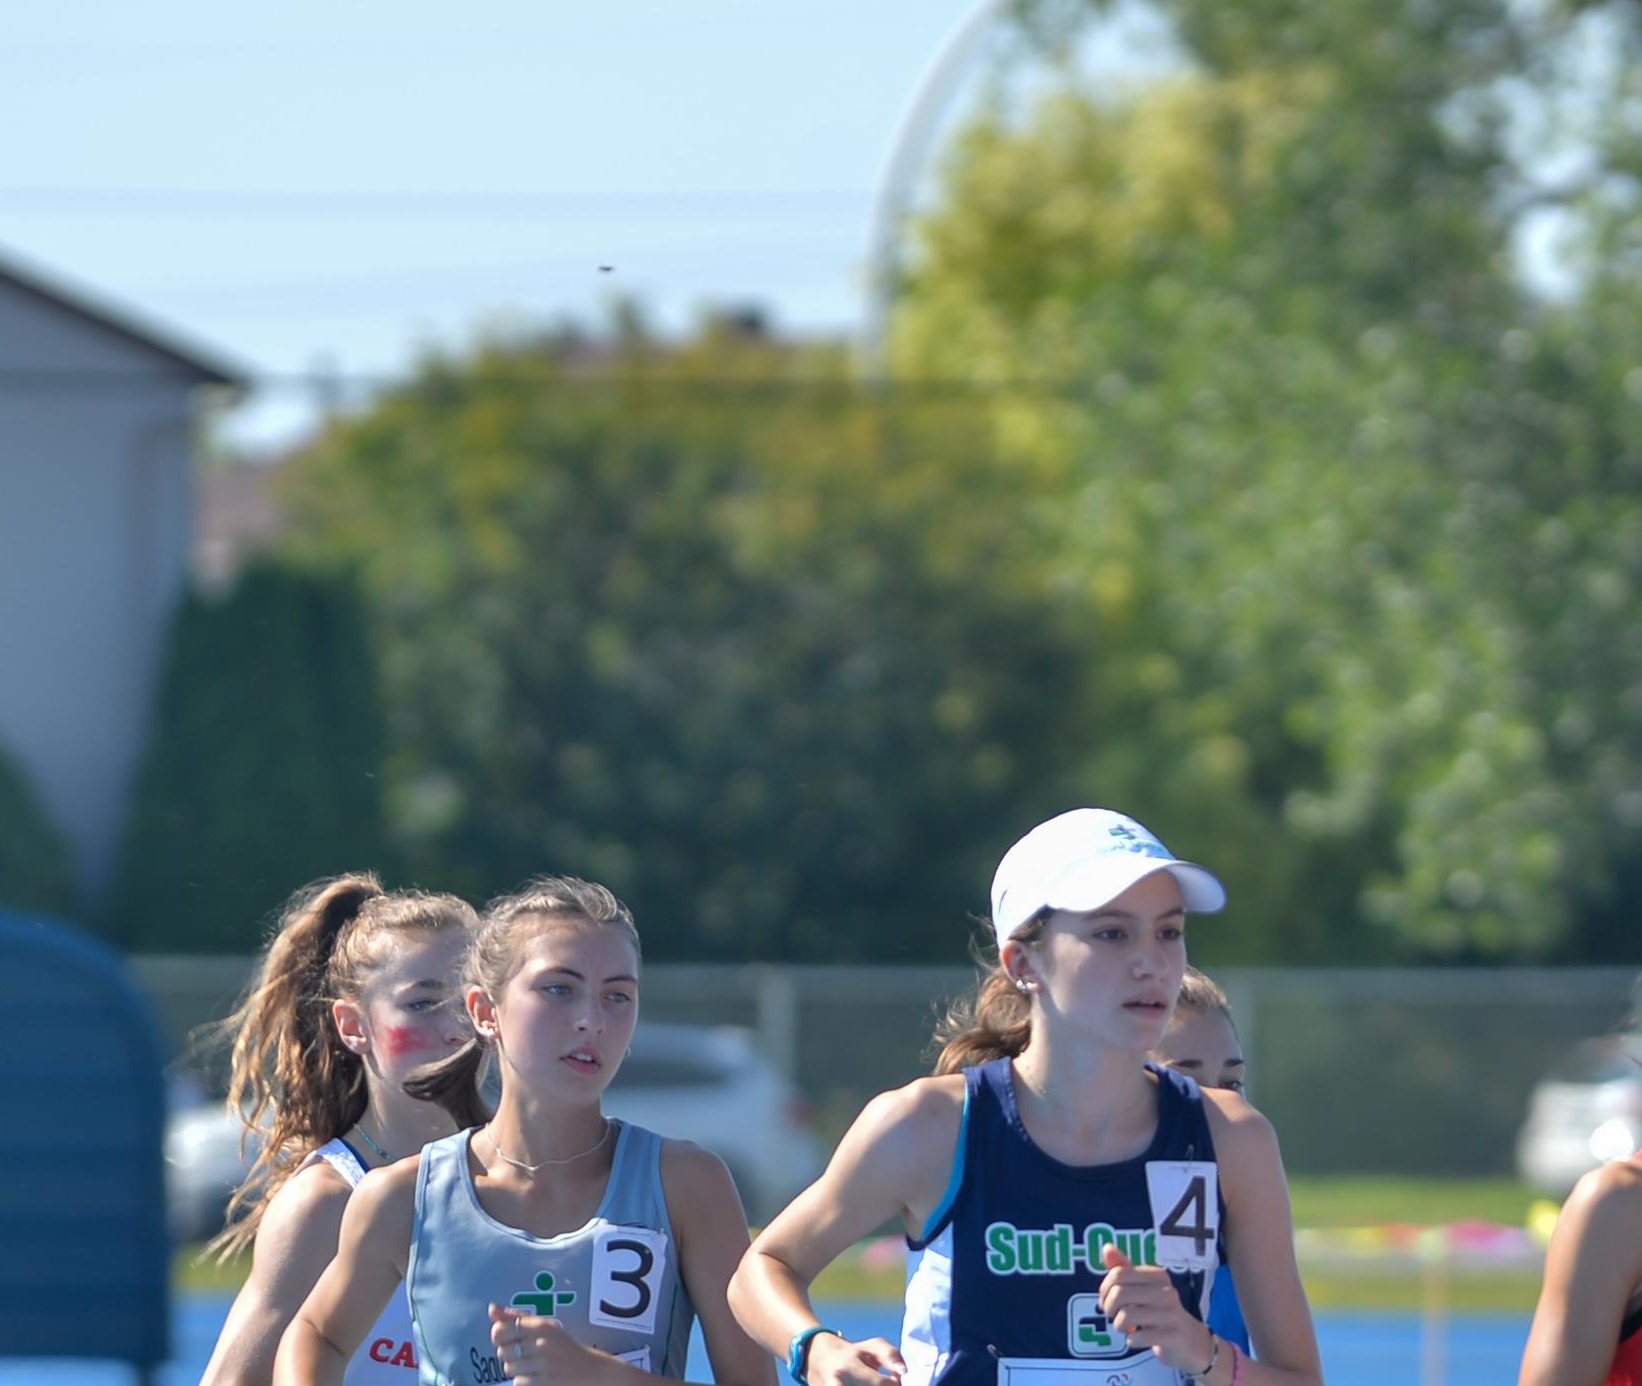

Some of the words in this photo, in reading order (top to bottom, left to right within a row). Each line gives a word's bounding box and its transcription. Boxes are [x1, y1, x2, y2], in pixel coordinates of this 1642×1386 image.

[1159, 1175, 1215, 1257] 4
[599, 1239, 654, 1318] 3
[369, 1338, 419, 1369] CA
